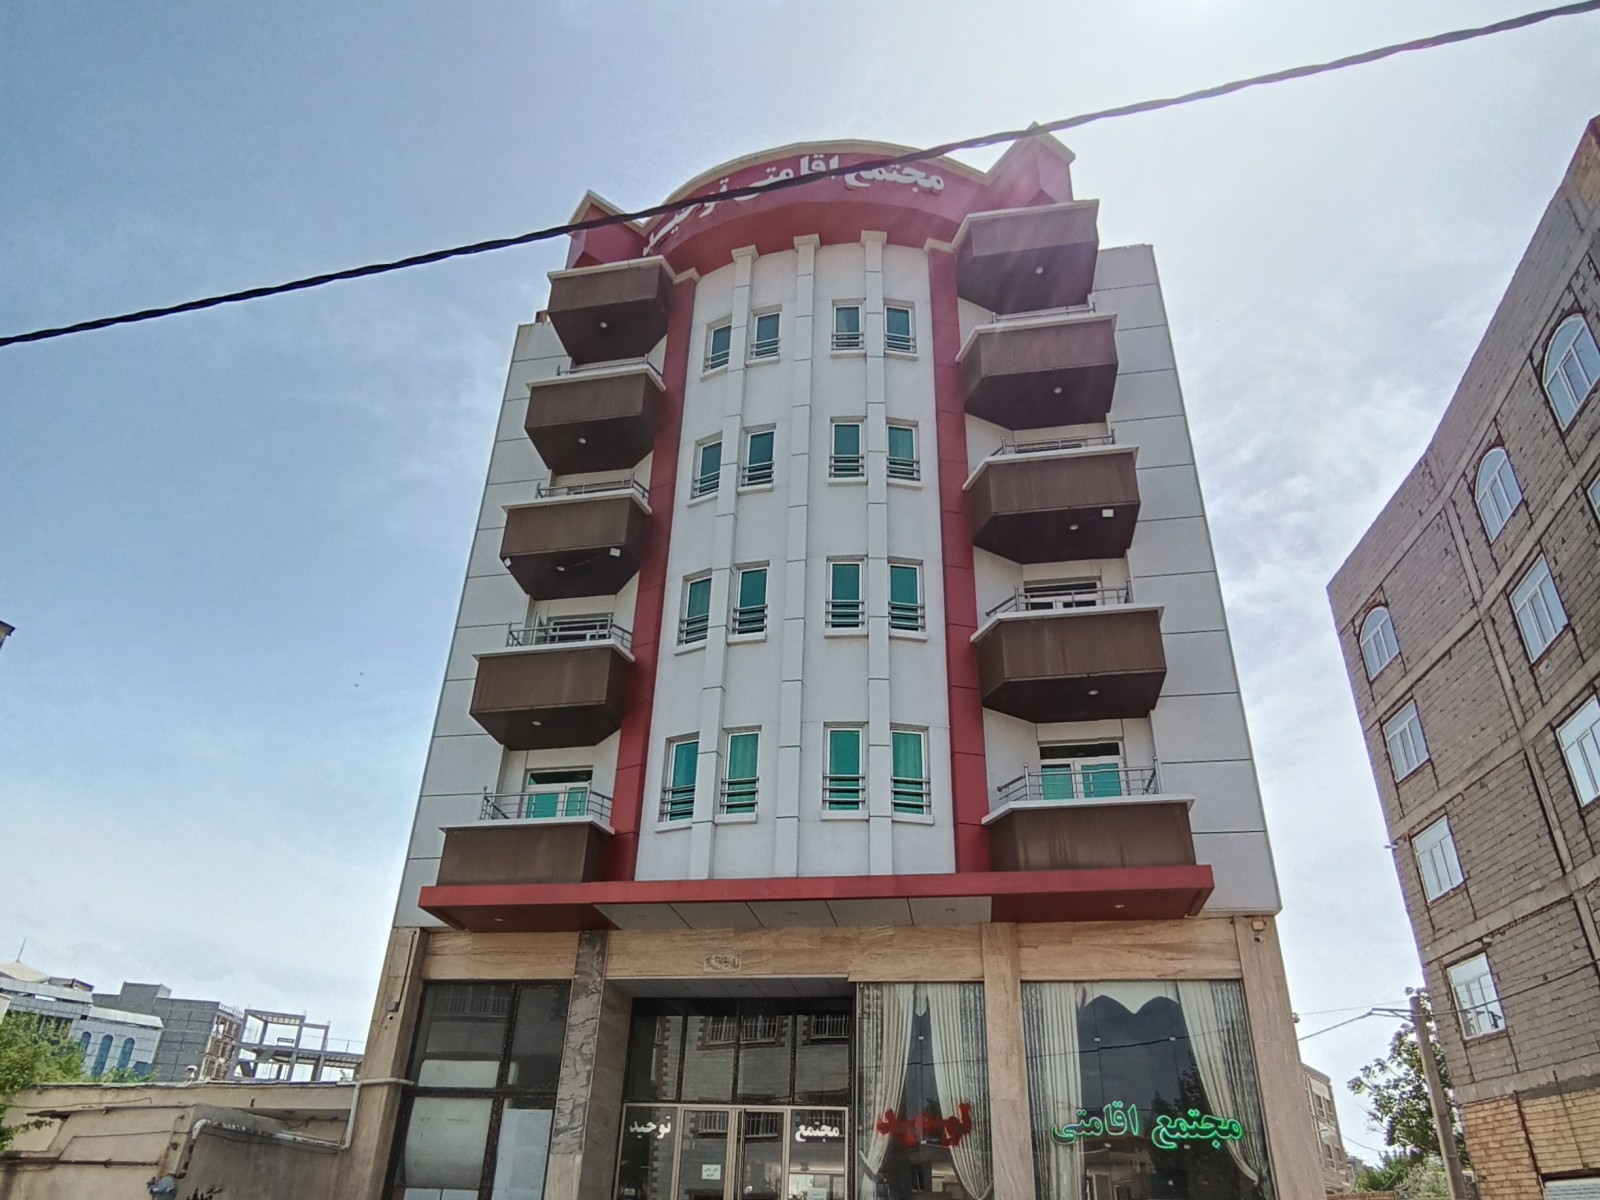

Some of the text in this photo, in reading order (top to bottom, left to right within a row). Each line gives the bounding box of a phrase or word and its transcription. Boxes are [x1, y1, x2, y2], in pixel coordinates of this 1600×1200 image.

[844, 162, 945, 193] مجتمع
[629, 1115, 671, 1139] توحید
[795, 1121, 840, 1142] مجتمع
[1051, 1100, 1243, 1149] مجتمع اقامتی
